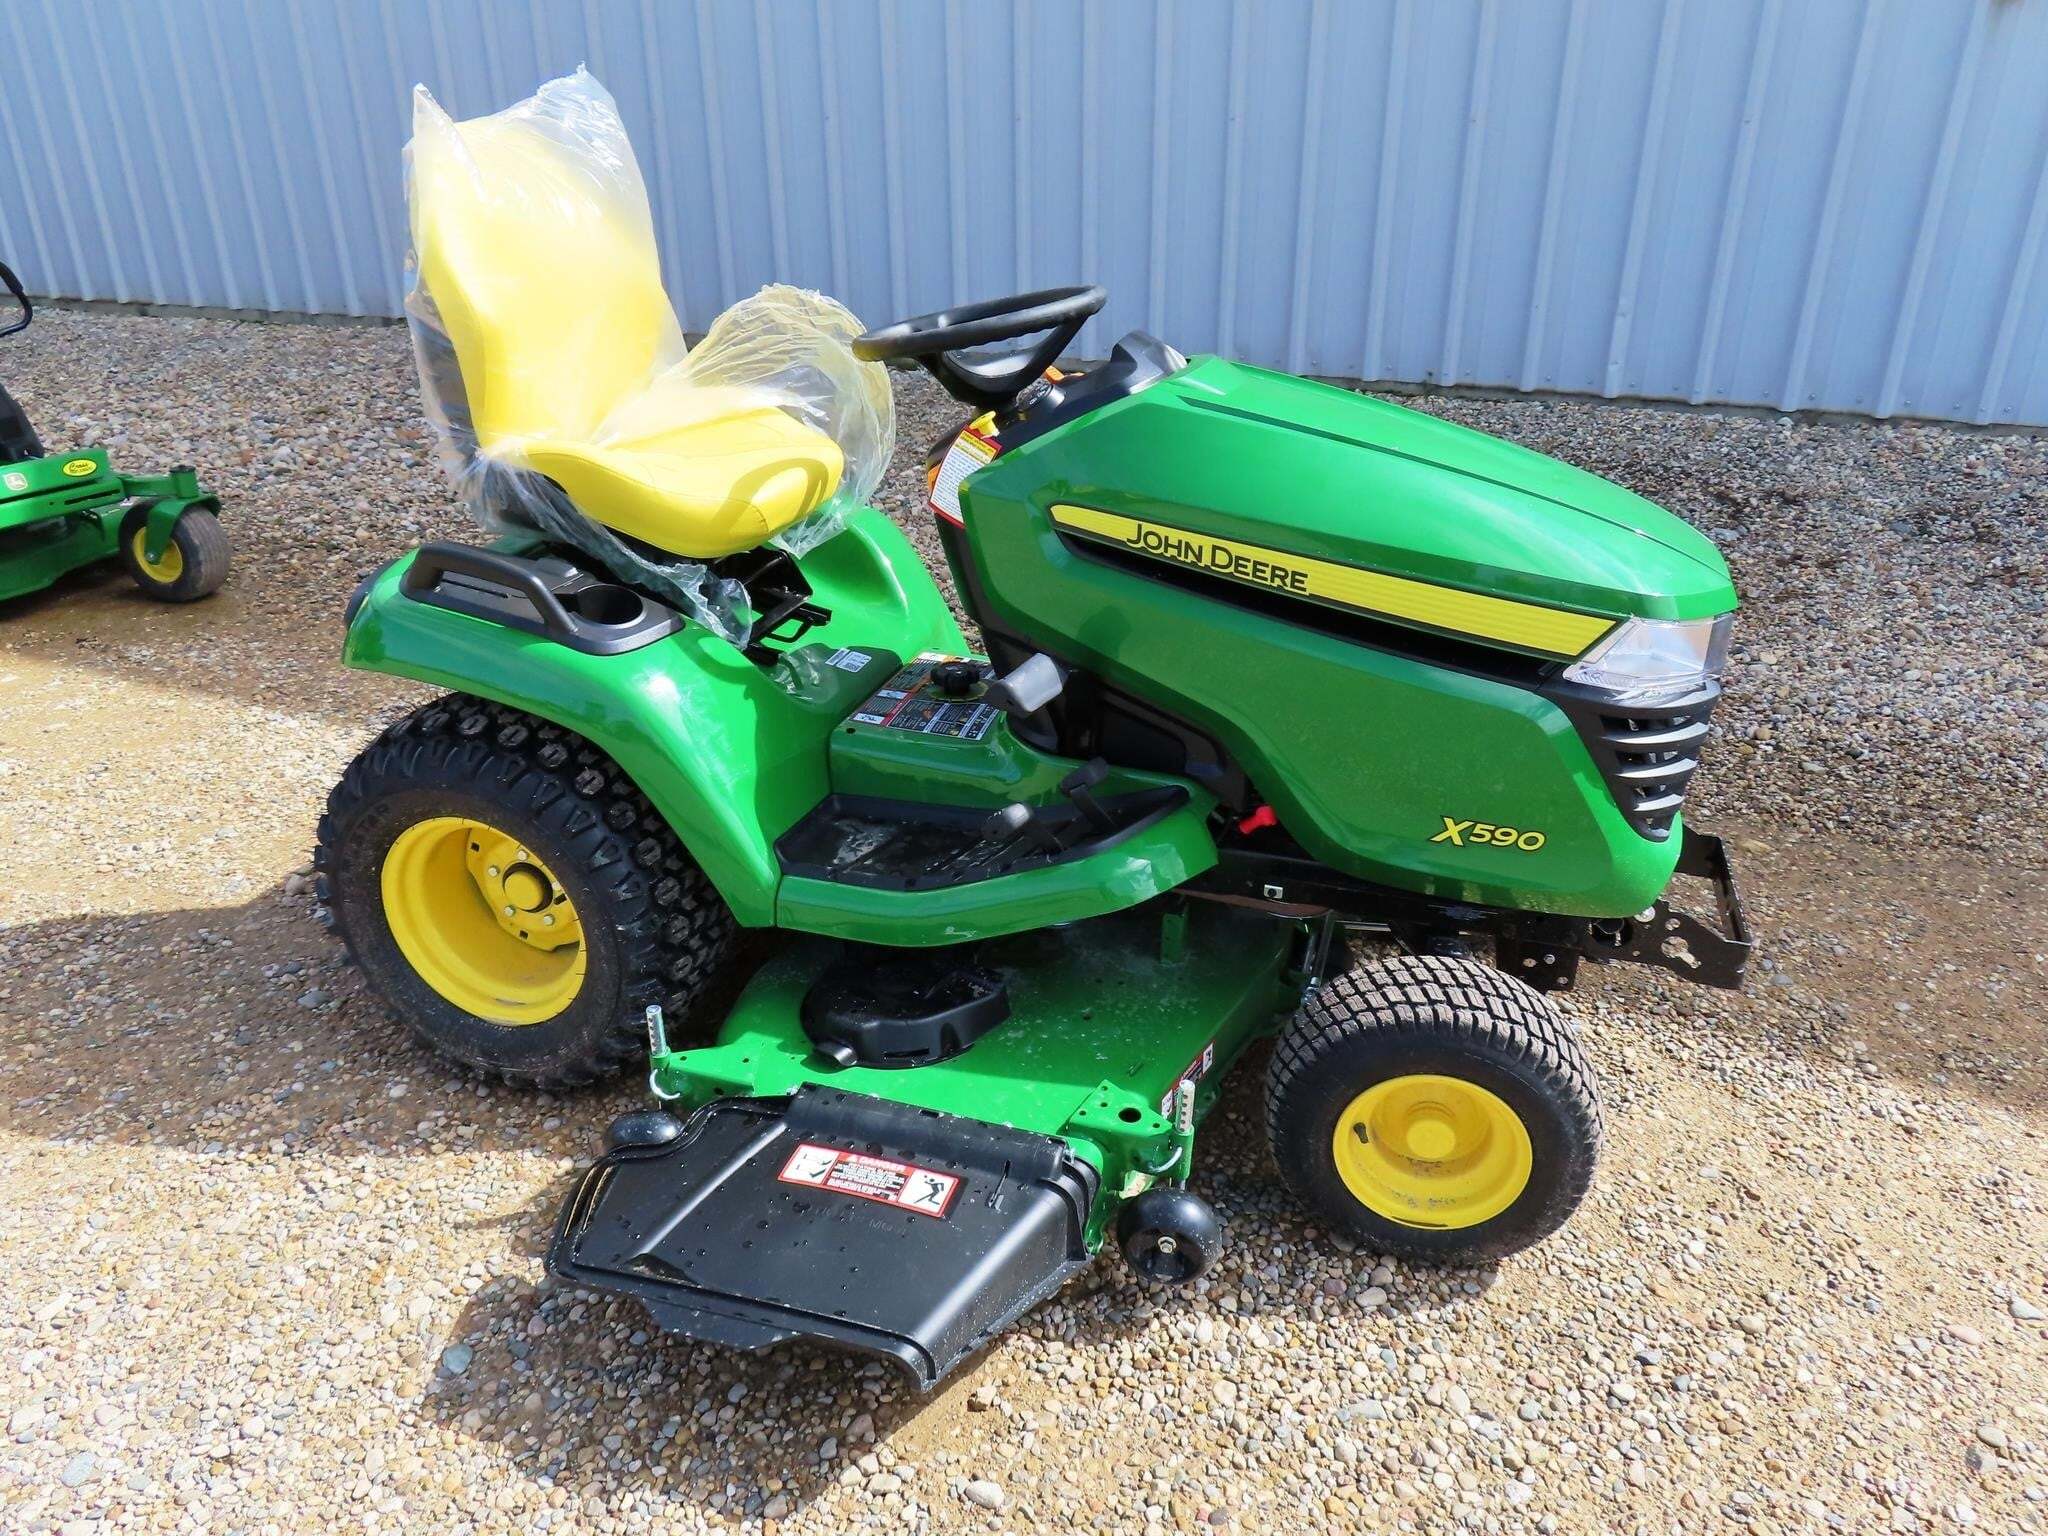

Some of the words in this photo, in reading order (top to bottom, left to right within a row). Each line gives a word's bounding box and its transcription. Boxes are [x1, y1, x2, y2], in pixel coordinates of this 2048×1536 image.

[1126, 522, 1204, 564] JOHN
[1210, 543, 1310, 593] DEERE
[1428, 815, 1546, 851] X590
